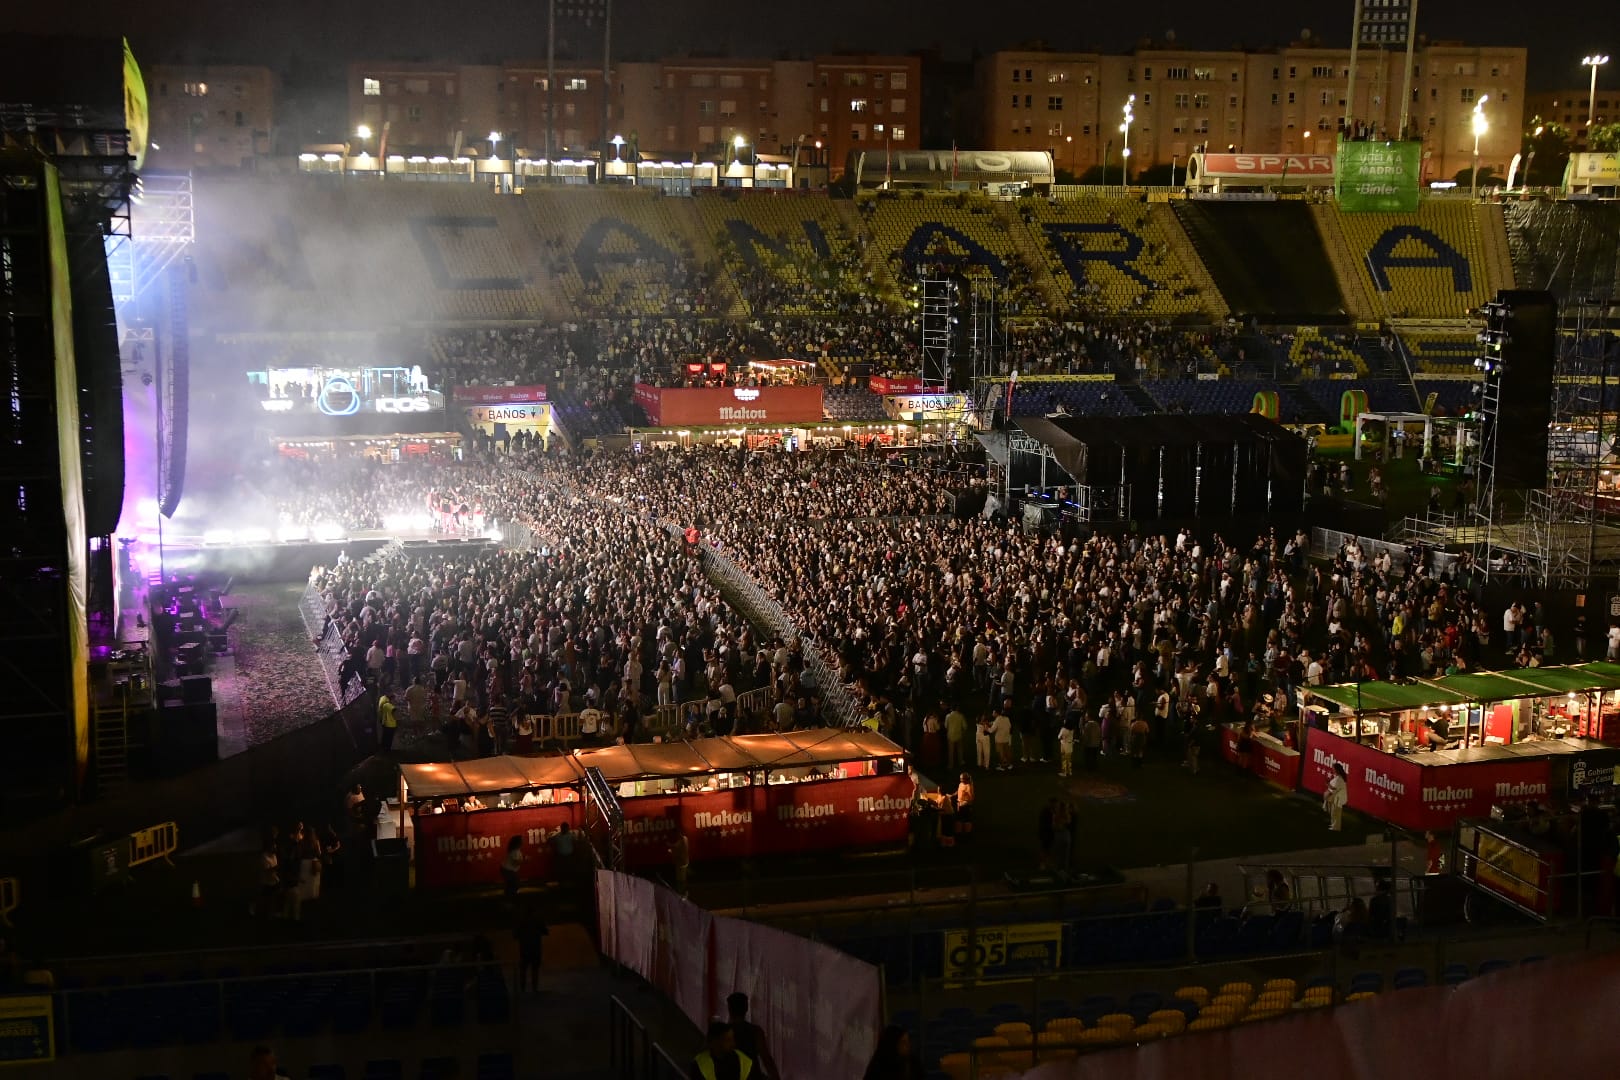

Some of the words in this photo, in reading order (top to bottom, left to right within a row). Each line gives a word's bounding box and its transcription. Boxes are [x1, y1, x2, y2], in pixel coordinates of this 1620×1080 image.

[1235, 157, 1331, 170] SPAR
[1360, 166, 1403, 175] MADRID
[375, 397, 430, 413] IQOS
[488, 407, 526, 419] BAÑOS
[719, 407, 767, 420] Mahou
[1365, 768, 1405, 795] Mahou
[1496, 780, 1547, 798] Mahou
[1422, 785, 1474, 802] Mahou
[694, 809, 752, 829] Mahou
[777, 801, 835, 820] Mahou
[436, 833, 501, 852] Mahou
